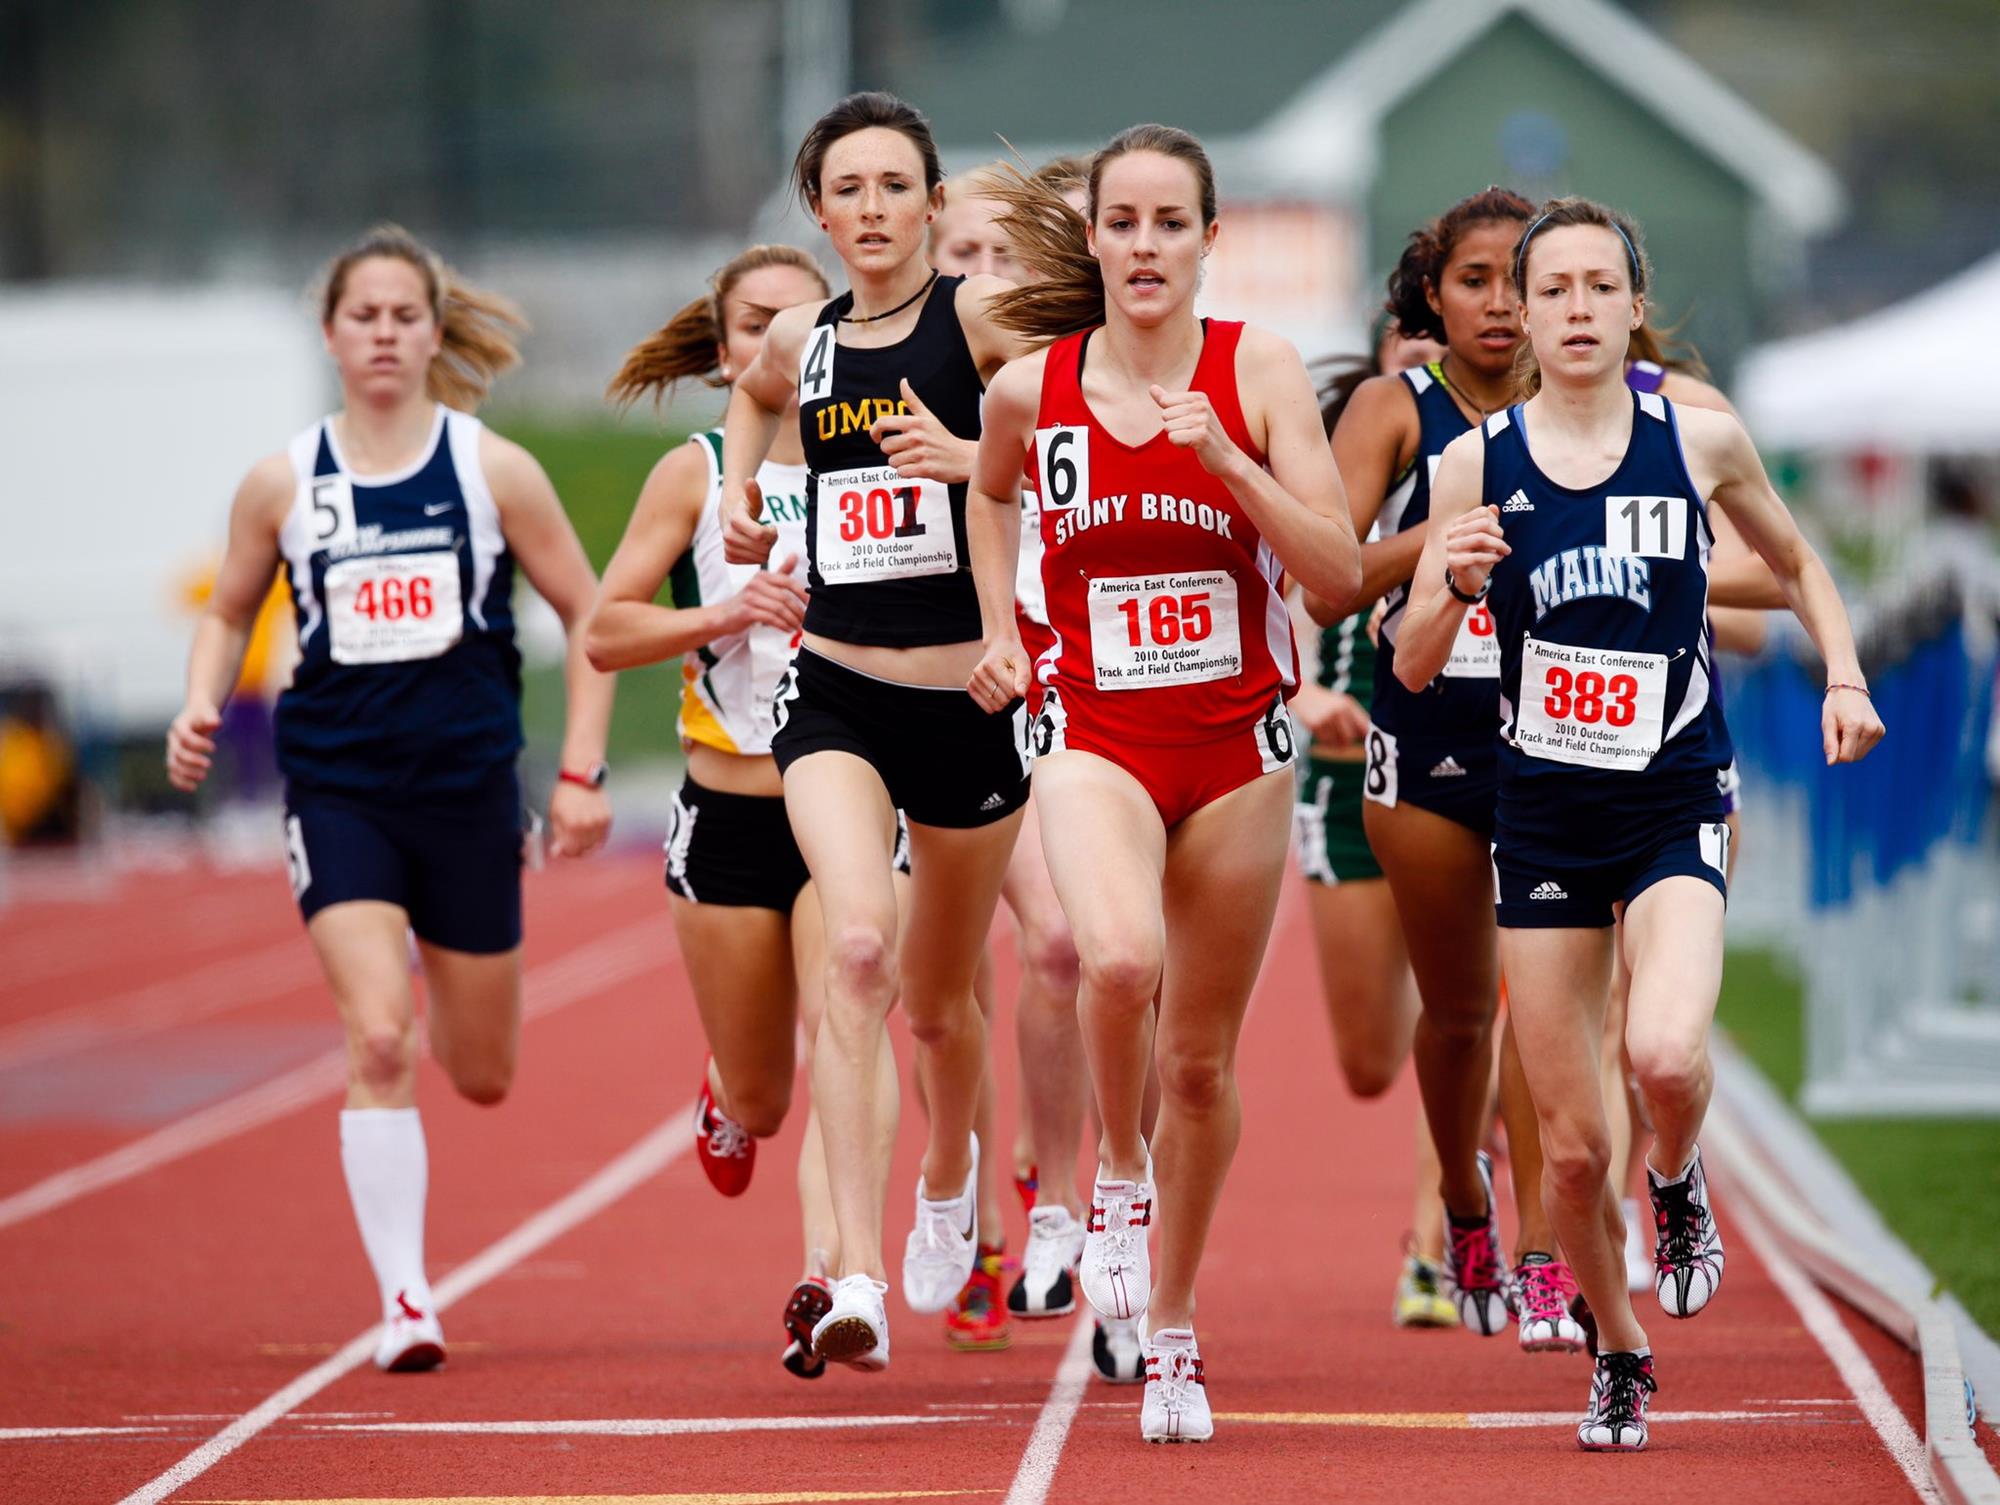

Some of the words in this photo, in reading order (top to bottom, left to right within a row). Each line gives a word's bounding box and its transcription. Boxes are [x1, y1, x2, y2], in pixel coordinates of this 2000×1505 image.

[804, 330, 829, 394] 4
[828, 474, 858, 487] America
[862, 471, 880, 483] East
[1047, 431, 1077, 505] 6
[312, 482, 340, 540] 5
[1055, 494, 1128, 545] STONY
[1141, 493, 1233, 540] BROOK
[1502, 502, 1535, 513] adidas
[1620, 500, 1669, 553] 11
[820, 561, 842, 572] Track
[845, 559, 860, 569] and
[863, 557, 884, 568] Field
[888, 551, 953, 567] Championship
[852, 545, 872, 556] 2010
[877, 543, 914, 554] Outdoor
[1100, 582, 1140, 593] America
[1144, 579, 1165, 591] East
[1170, 576, 1224, 589] Conference
[1529, 545, 1652, 623] MAINE
[354, 576, 434, 621] 466
[1117, 592, 1212, 647] 165
[1135, 650, 1158, 662] 2010
[1162, 648, 1201, 660] Outdoor
[1449, 654, 1468, 664] rack
[1482, 640, 1500, 651] 201
[1535, 645, 1571, 662] America
[1575, 651, 1596, 665] East
[1600, 654, 1655, 670] Conference
[1098, 667, 1123, 678] Track
[1127, 665, 1144, 676] and
[1148, 663, 1174, 675] Field
[1174, 655, 1239, 673] Championship
[1544, 666, 1638, 727] 383
[1264, 694, 1293, 763] 6
[1555, 723, 1577, 737] 2010
[1580, 727, 1619, 741] Outdoor
[1520, 729, 1543, 743] Track
[1546, 736, 1562, 747] and
[1565, 739, 1586, 751] Field
[1590, 742, 1656, 760] Championship
[1367, 730, 1387, 795] 8
[1529, 889, 1568, 900] adidas
